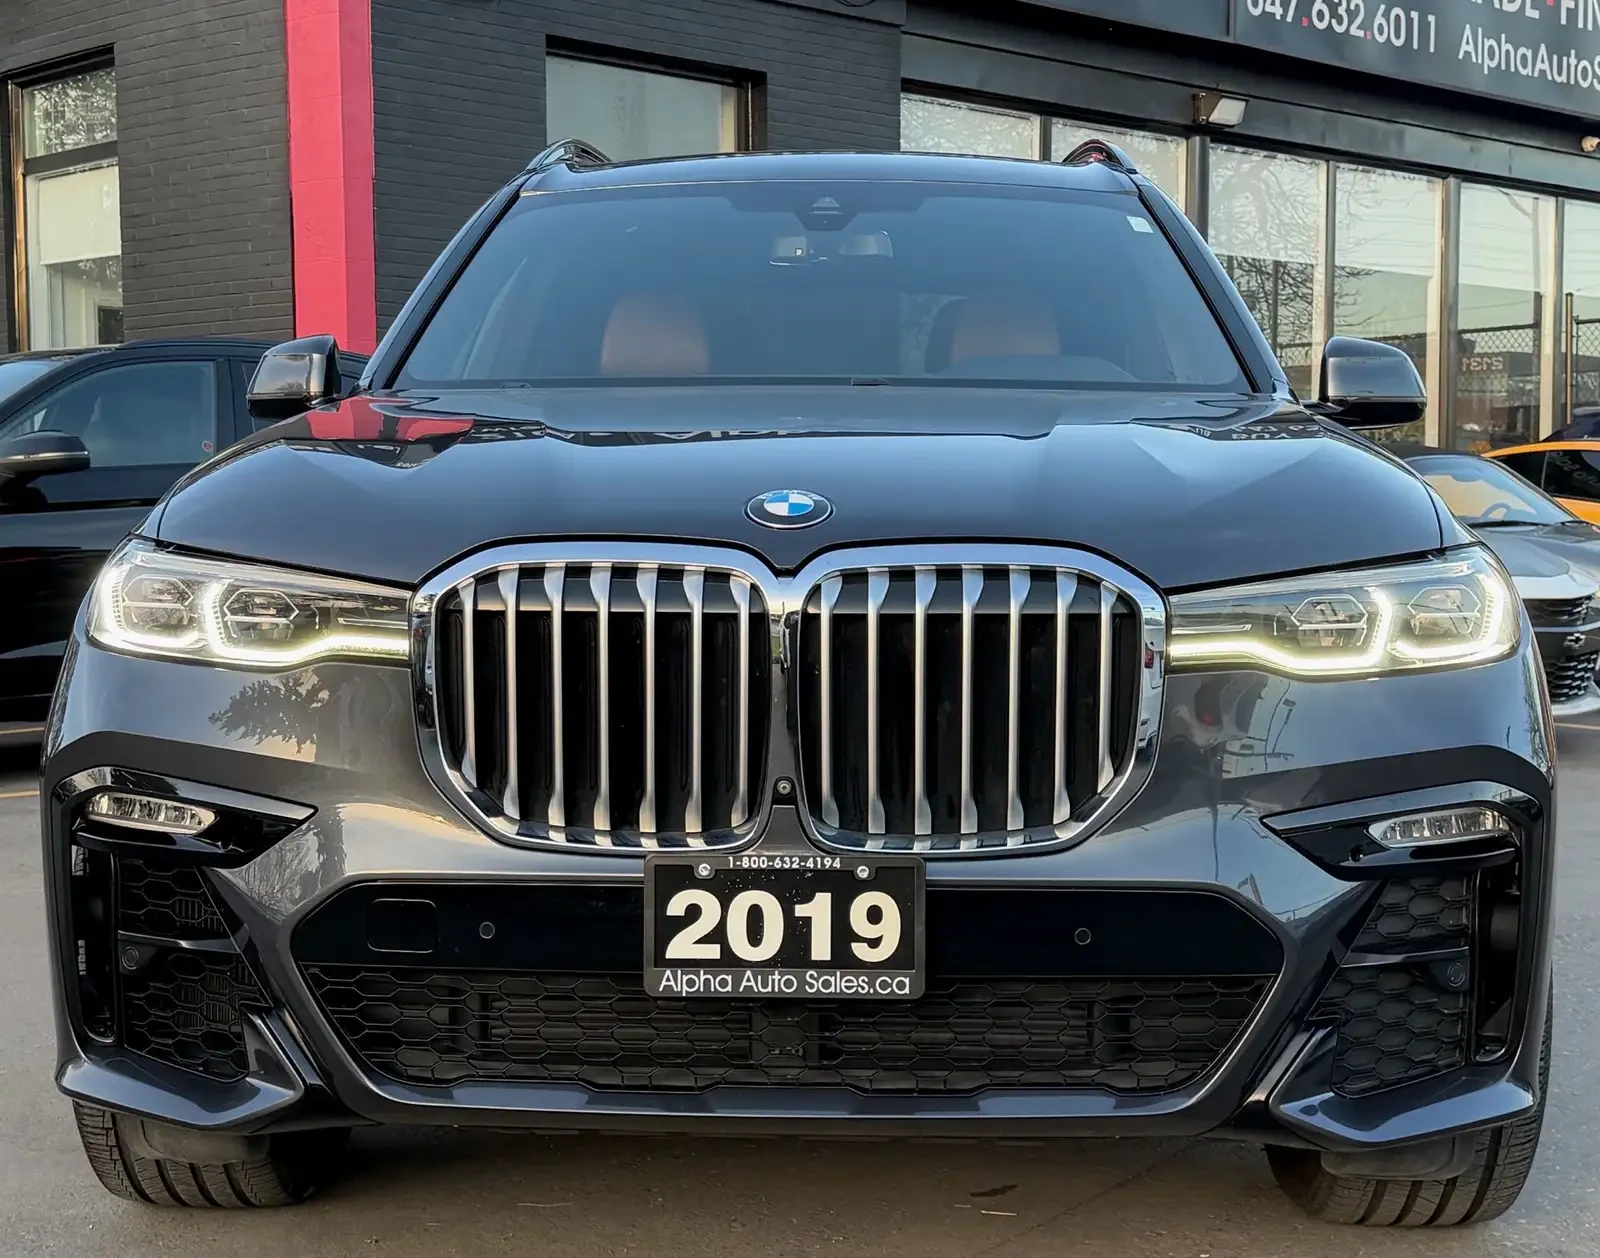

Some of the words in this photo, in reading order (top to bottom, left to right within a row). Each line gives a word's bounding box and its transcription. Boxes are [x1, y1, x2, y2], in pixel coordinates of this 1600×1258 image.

[728, 856, 841, 869] 1-800-632-4194
[665, 889, 901, 963] 2019
[659, 969, 732, 996] Alpha
[739, 970, 798, 993] Auto
[805, 970, 910, 995] Sales.ca
